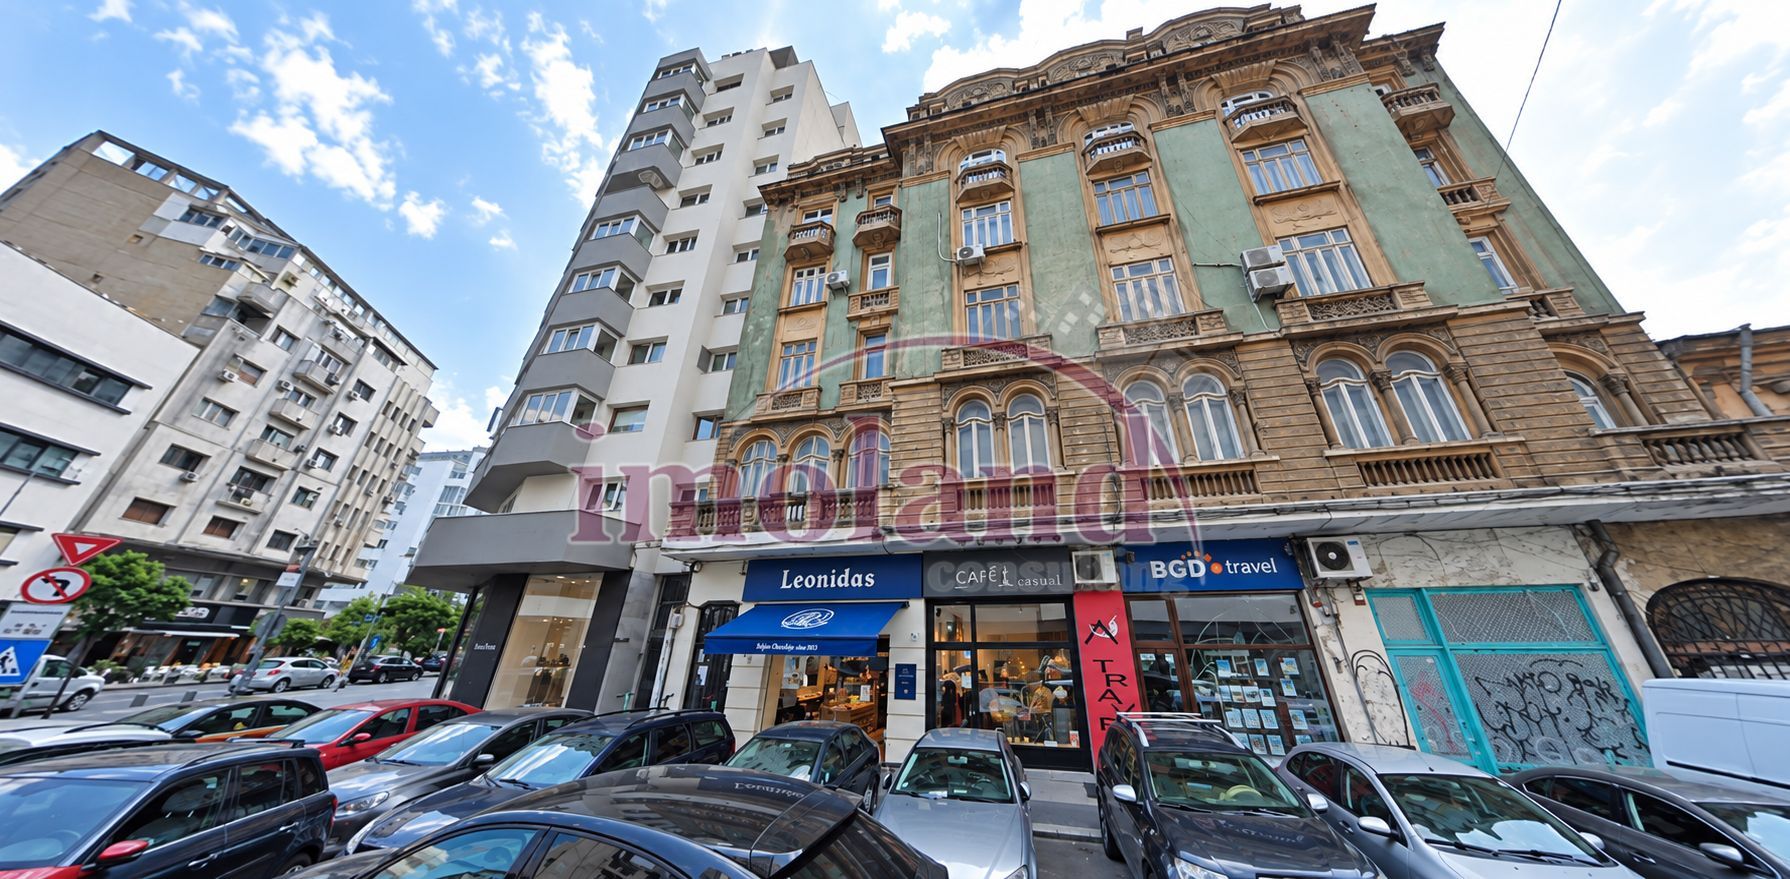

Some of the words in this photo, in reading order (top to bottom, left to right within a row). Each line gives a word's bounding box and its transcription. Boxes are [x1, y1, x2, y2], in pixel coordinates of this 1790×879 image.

[780, 567, 875, 589] Leonidas
[1149, 559, 1206, 579] BGD
[1225, 557, 1278, 574] travel
[1018, 574, 1062, 587] casual
